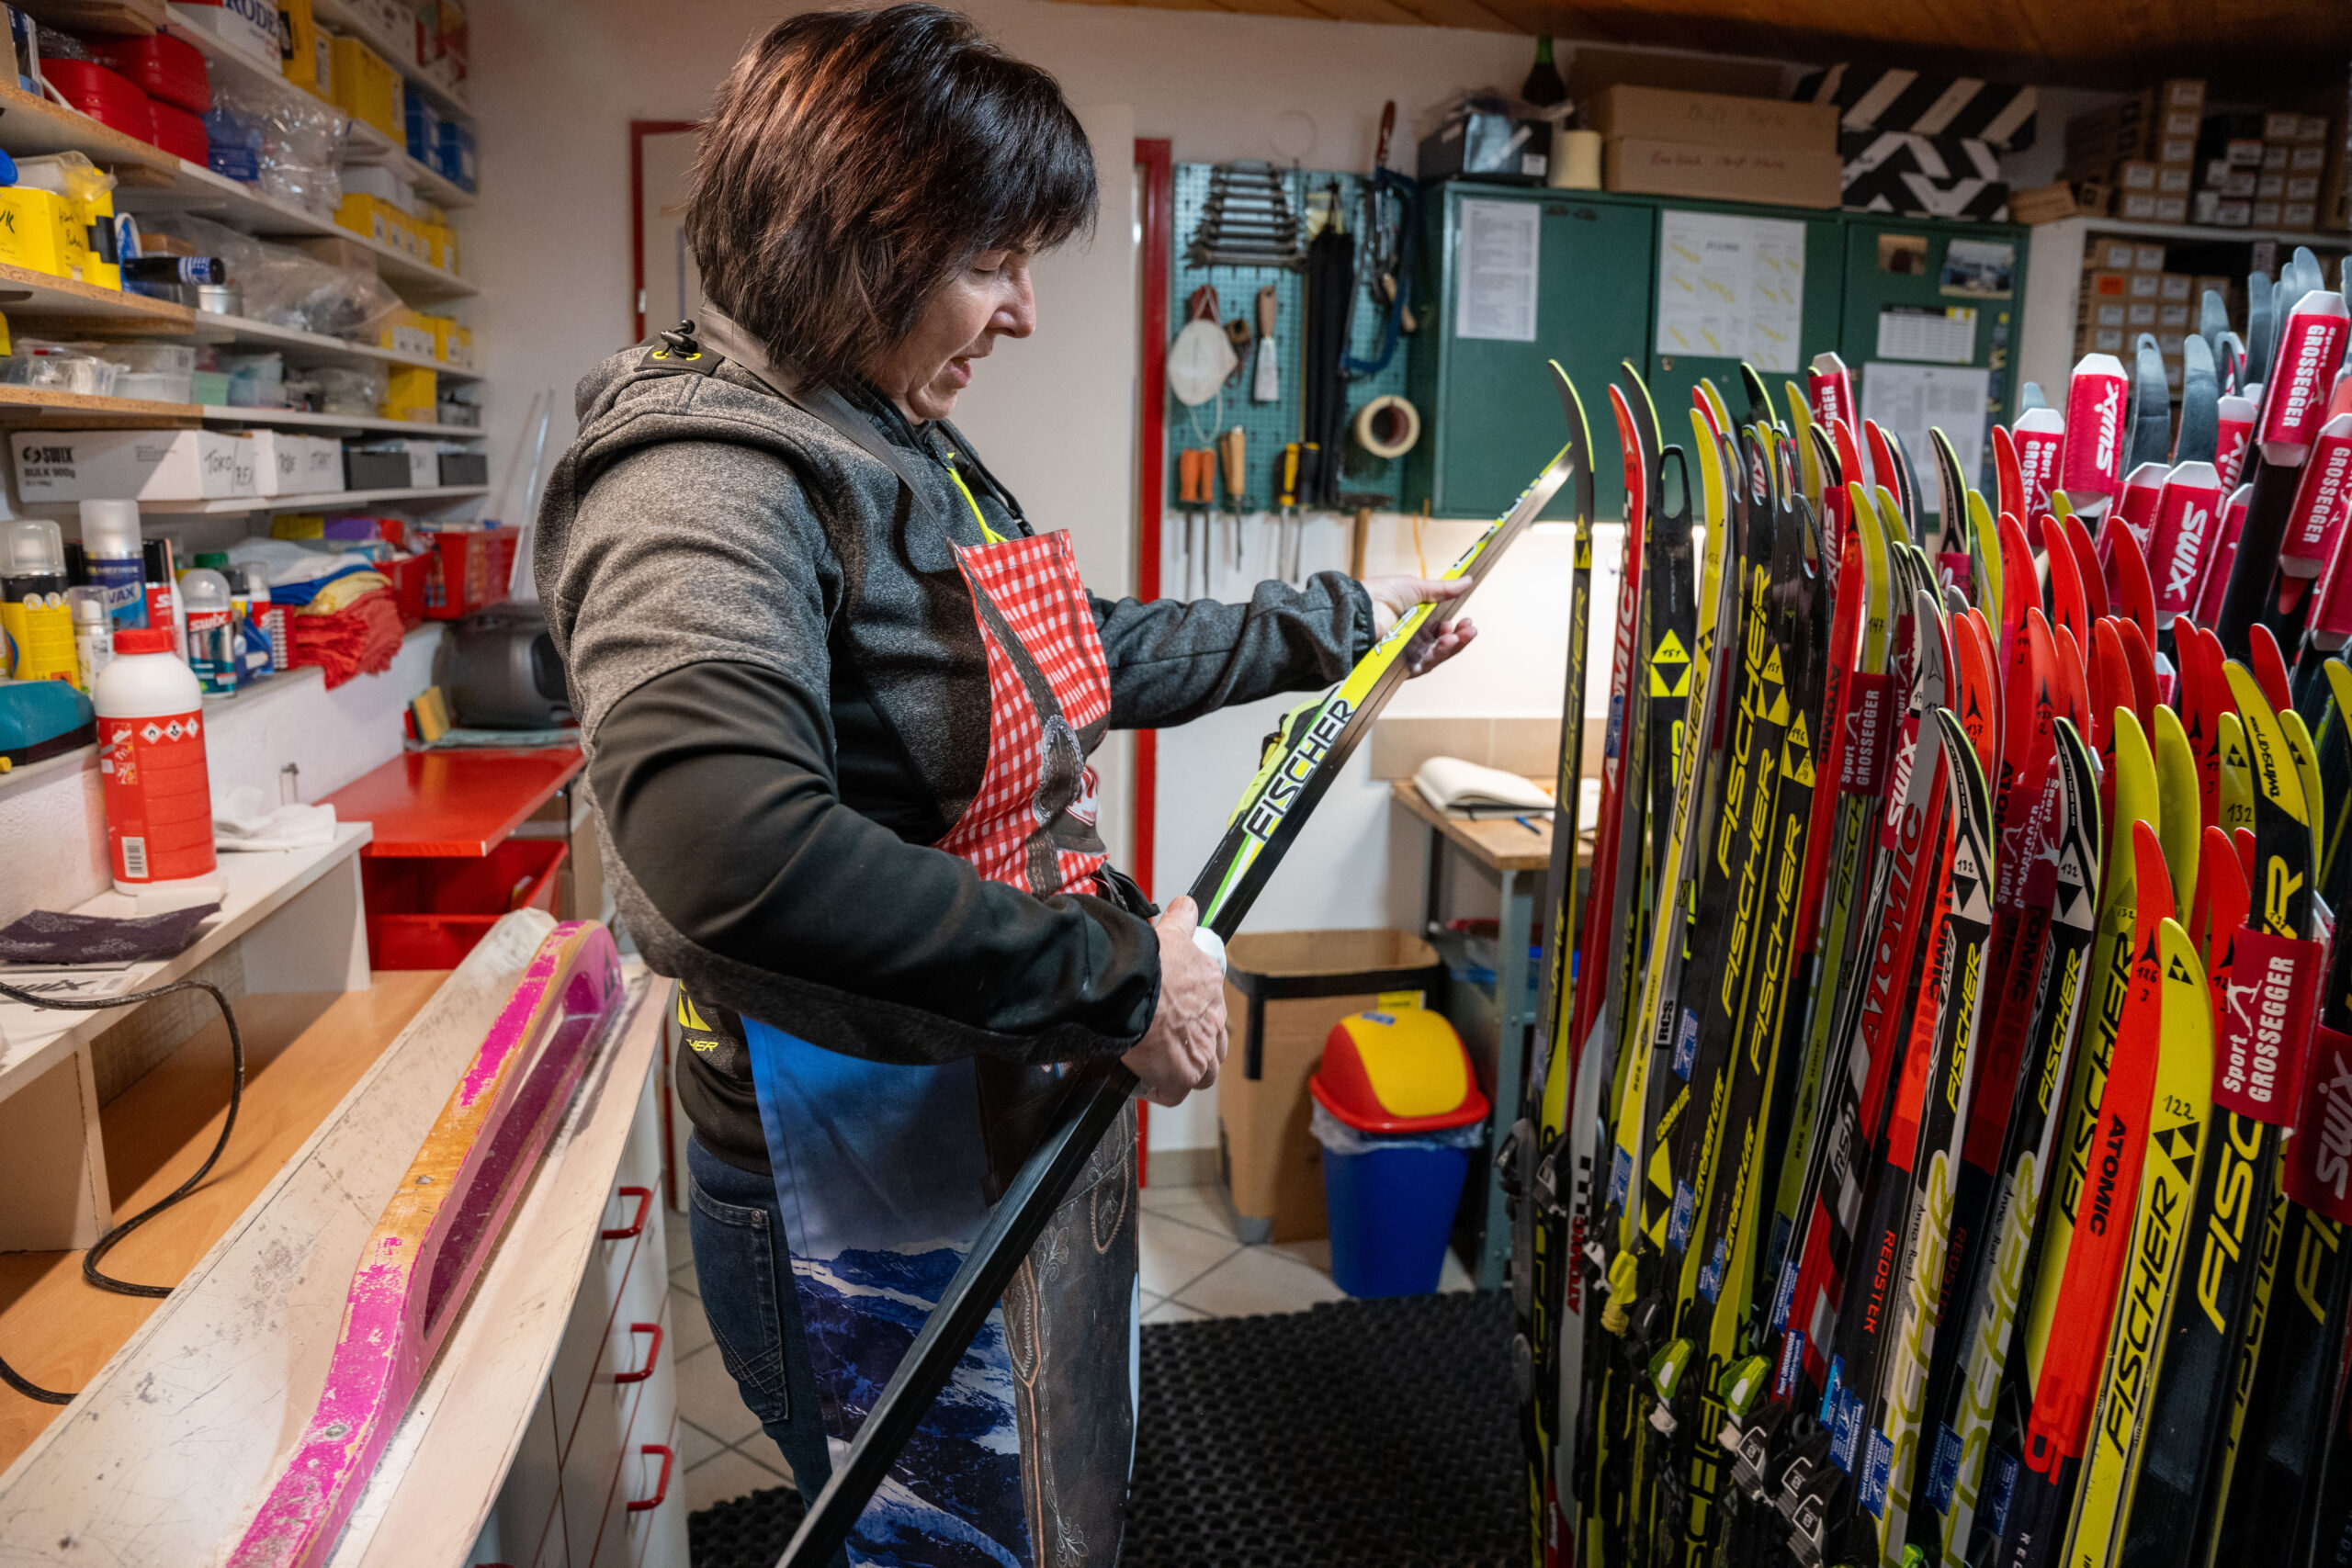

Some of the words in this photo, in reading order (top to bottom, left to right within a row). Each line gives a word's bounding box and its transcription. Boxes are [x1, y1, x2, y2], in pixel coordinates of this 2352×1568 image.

[2281, 324, 2325, 428] GROSSEGGER
[24, 468, 51, 477] BULK
[2039, 441, 2057, 479] Sport
[2302, 446, 2351, 544] GROSSEGGER
[1561, 587, 1587, 815] FISCHER
[1718, 563, 1771, 880] FISCHER
[1818, 662, 1841, 766] ATOMIC
[1857, 690, 1880, 786] GROSSEGGER
[1896, 688, 1907, 728] Sport
[1245, 699, 1356, 841] FISCHER
[1673, 670, 1706, 847] FISCHER
[1840, 745, 1855, 784] Sport
[2226, 805, 2253, 823] 132
[1721, 749, 1775, 1019] FISCHER
[1957, 860, 1974, 872] 132
[1996, 863, 2013, 905] Sport
[2060, 863, 2078, 877] 132
[1749, 814, 1802, 1076] FISCHER
[1861, 802, 1923, 1059] ATOMIC
[2137, 967, 2159, 984] 126
[1658, 998, 1674, 1042] RCS
[1946, 942, 1982, 1114] FISCHER
[2037, 947, 2083, 1117] FISCHER
[2140, 989, 2150, 1003] 3
[2247, 955, 2296, 1104] GROSSEGGER
[2162, 1093, 2196, 1122] 122
[2222, 1032, 2250, 1094] Sport
[1996, 1185, 2015, 1224] Anna
[2090, 1112, 2127, 1237] ATOMIC
[1911, 1204, 1927, 1245] Anna
[1862, 1228, 1897, 1335] REDSTER
[2107, 1175, 2179, 1460] FISCHER
